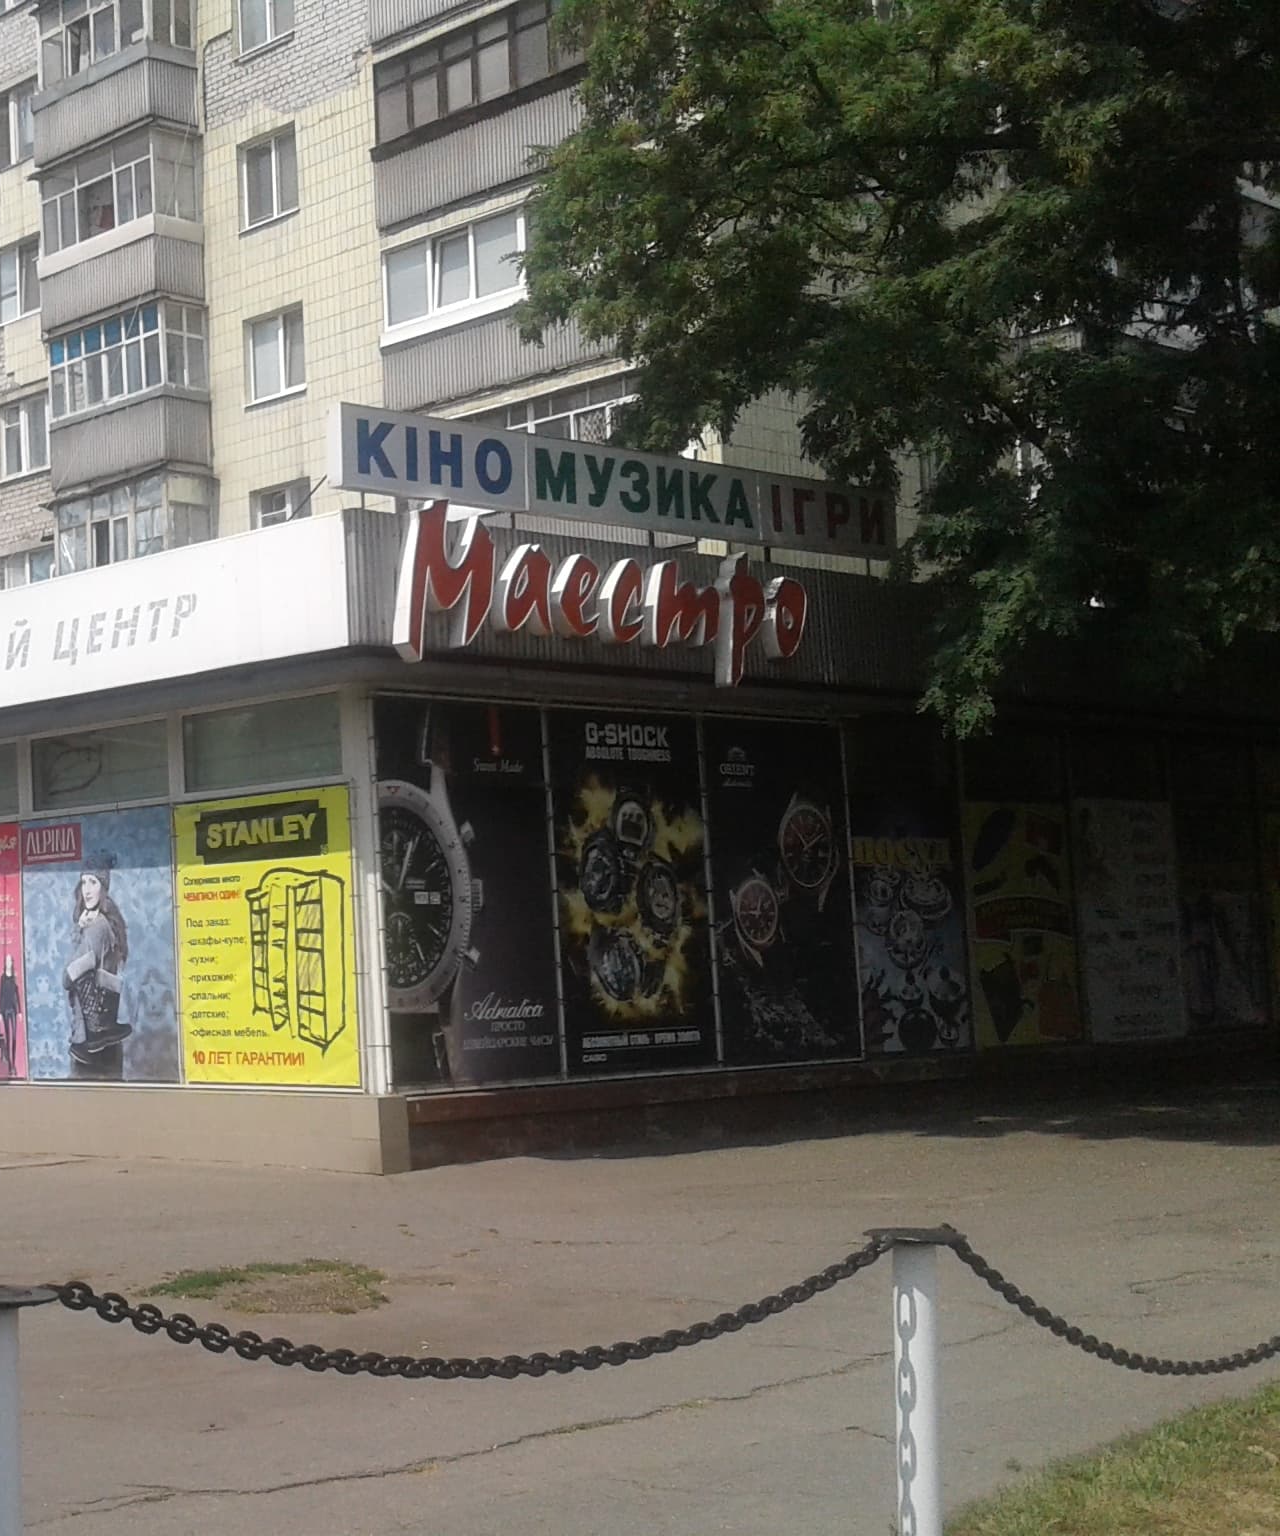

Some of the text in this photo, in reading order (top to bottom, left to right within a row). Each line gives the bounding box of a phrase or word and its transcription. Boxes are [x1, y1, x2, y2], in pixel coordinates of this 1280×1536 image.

[356, 417, 887, 546] КІНО МУЗИКА ІГРИ
[392, 500, 808, 688] Маестро
[52, 593, 199, 666] ЦЕНТР
[584, 721, 669, 748] G-SHOCK
[25, 827, 77, 855] ALPINA
[206, 812, 317, 849] STANLEY
[463, 991, 545, 1022] Adriatica
[192, 1050, 306, 1067] 10 ЛЕТ ГАРАНТИИ!
